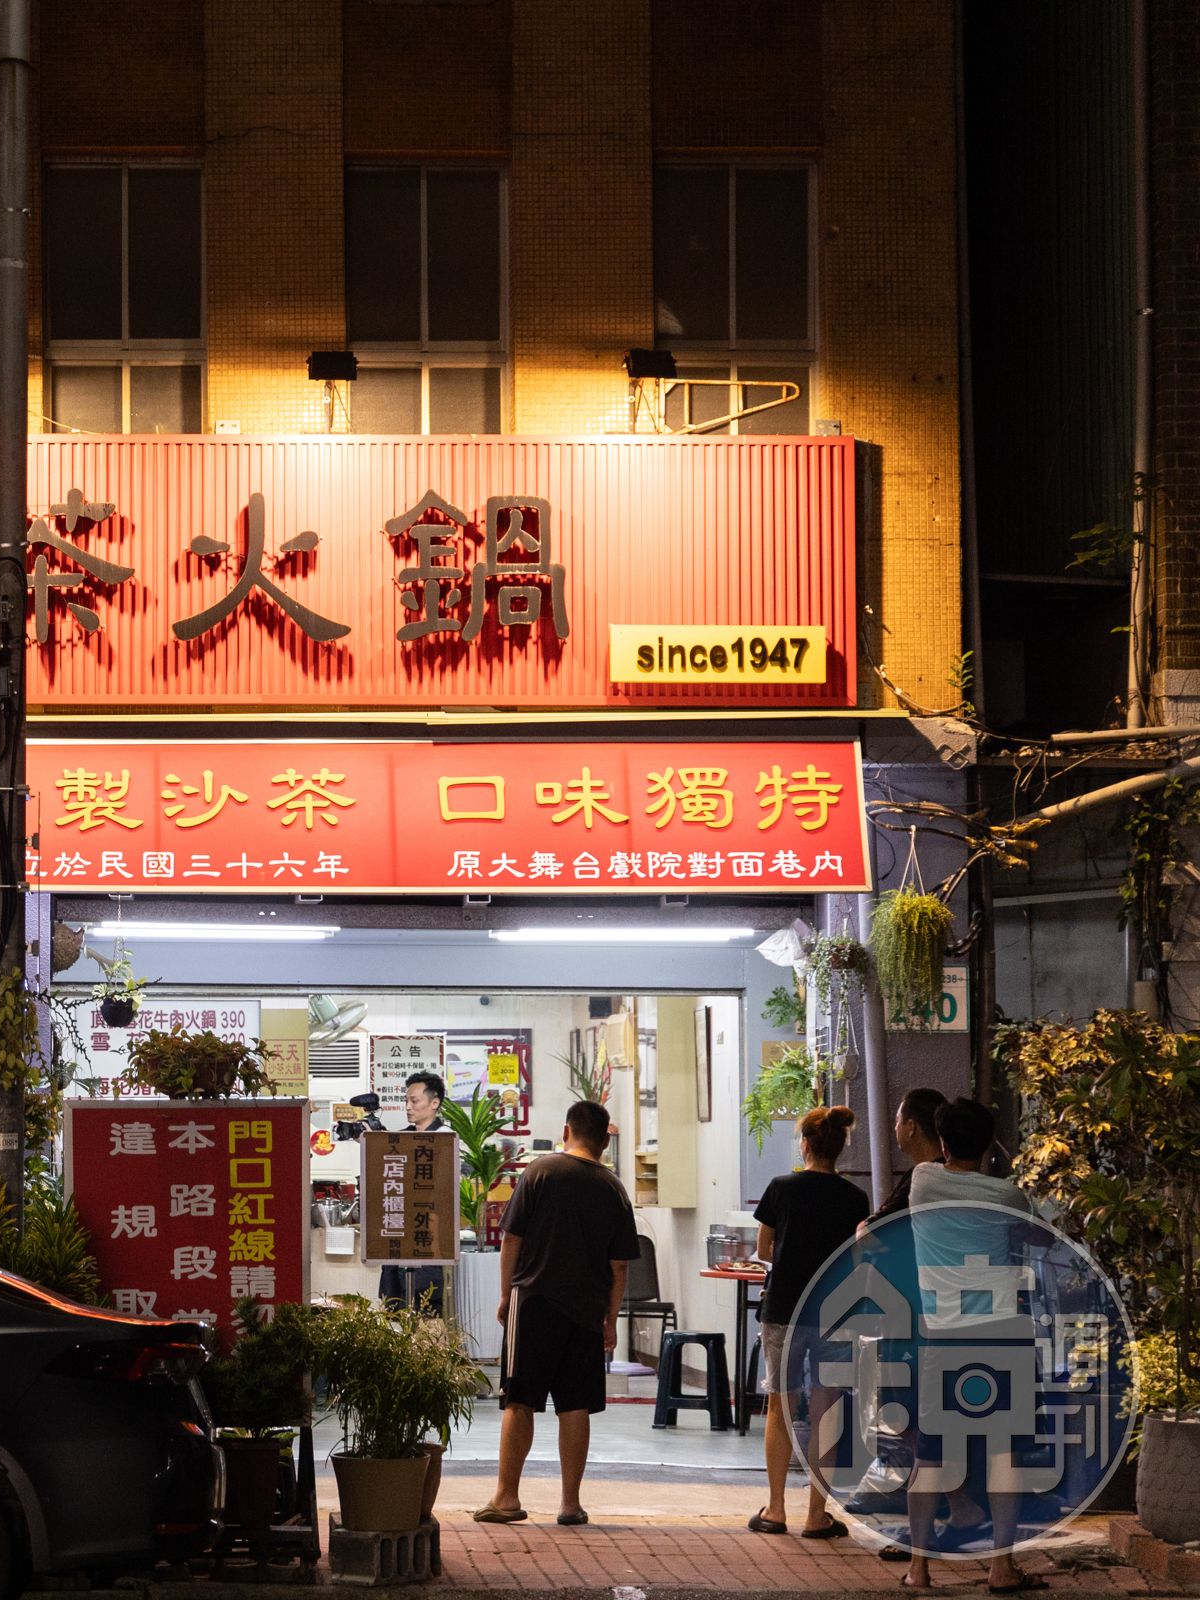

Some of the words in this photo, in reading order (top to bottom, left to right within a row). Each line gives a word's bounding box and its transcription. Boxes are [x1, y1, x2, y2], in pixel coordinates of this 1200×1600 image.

[637, 637, 811, 675] since1947
[438, 763, 844, 832] 口味獨特
[446, 849, 845, 879] 原大舞台戲院對面巷內
[90, 1010, 217, 1029] 頂花牛肉火鍋
[220, 1010, 246, 1029] 390
[390, 1045, 421, 1058] 公告
